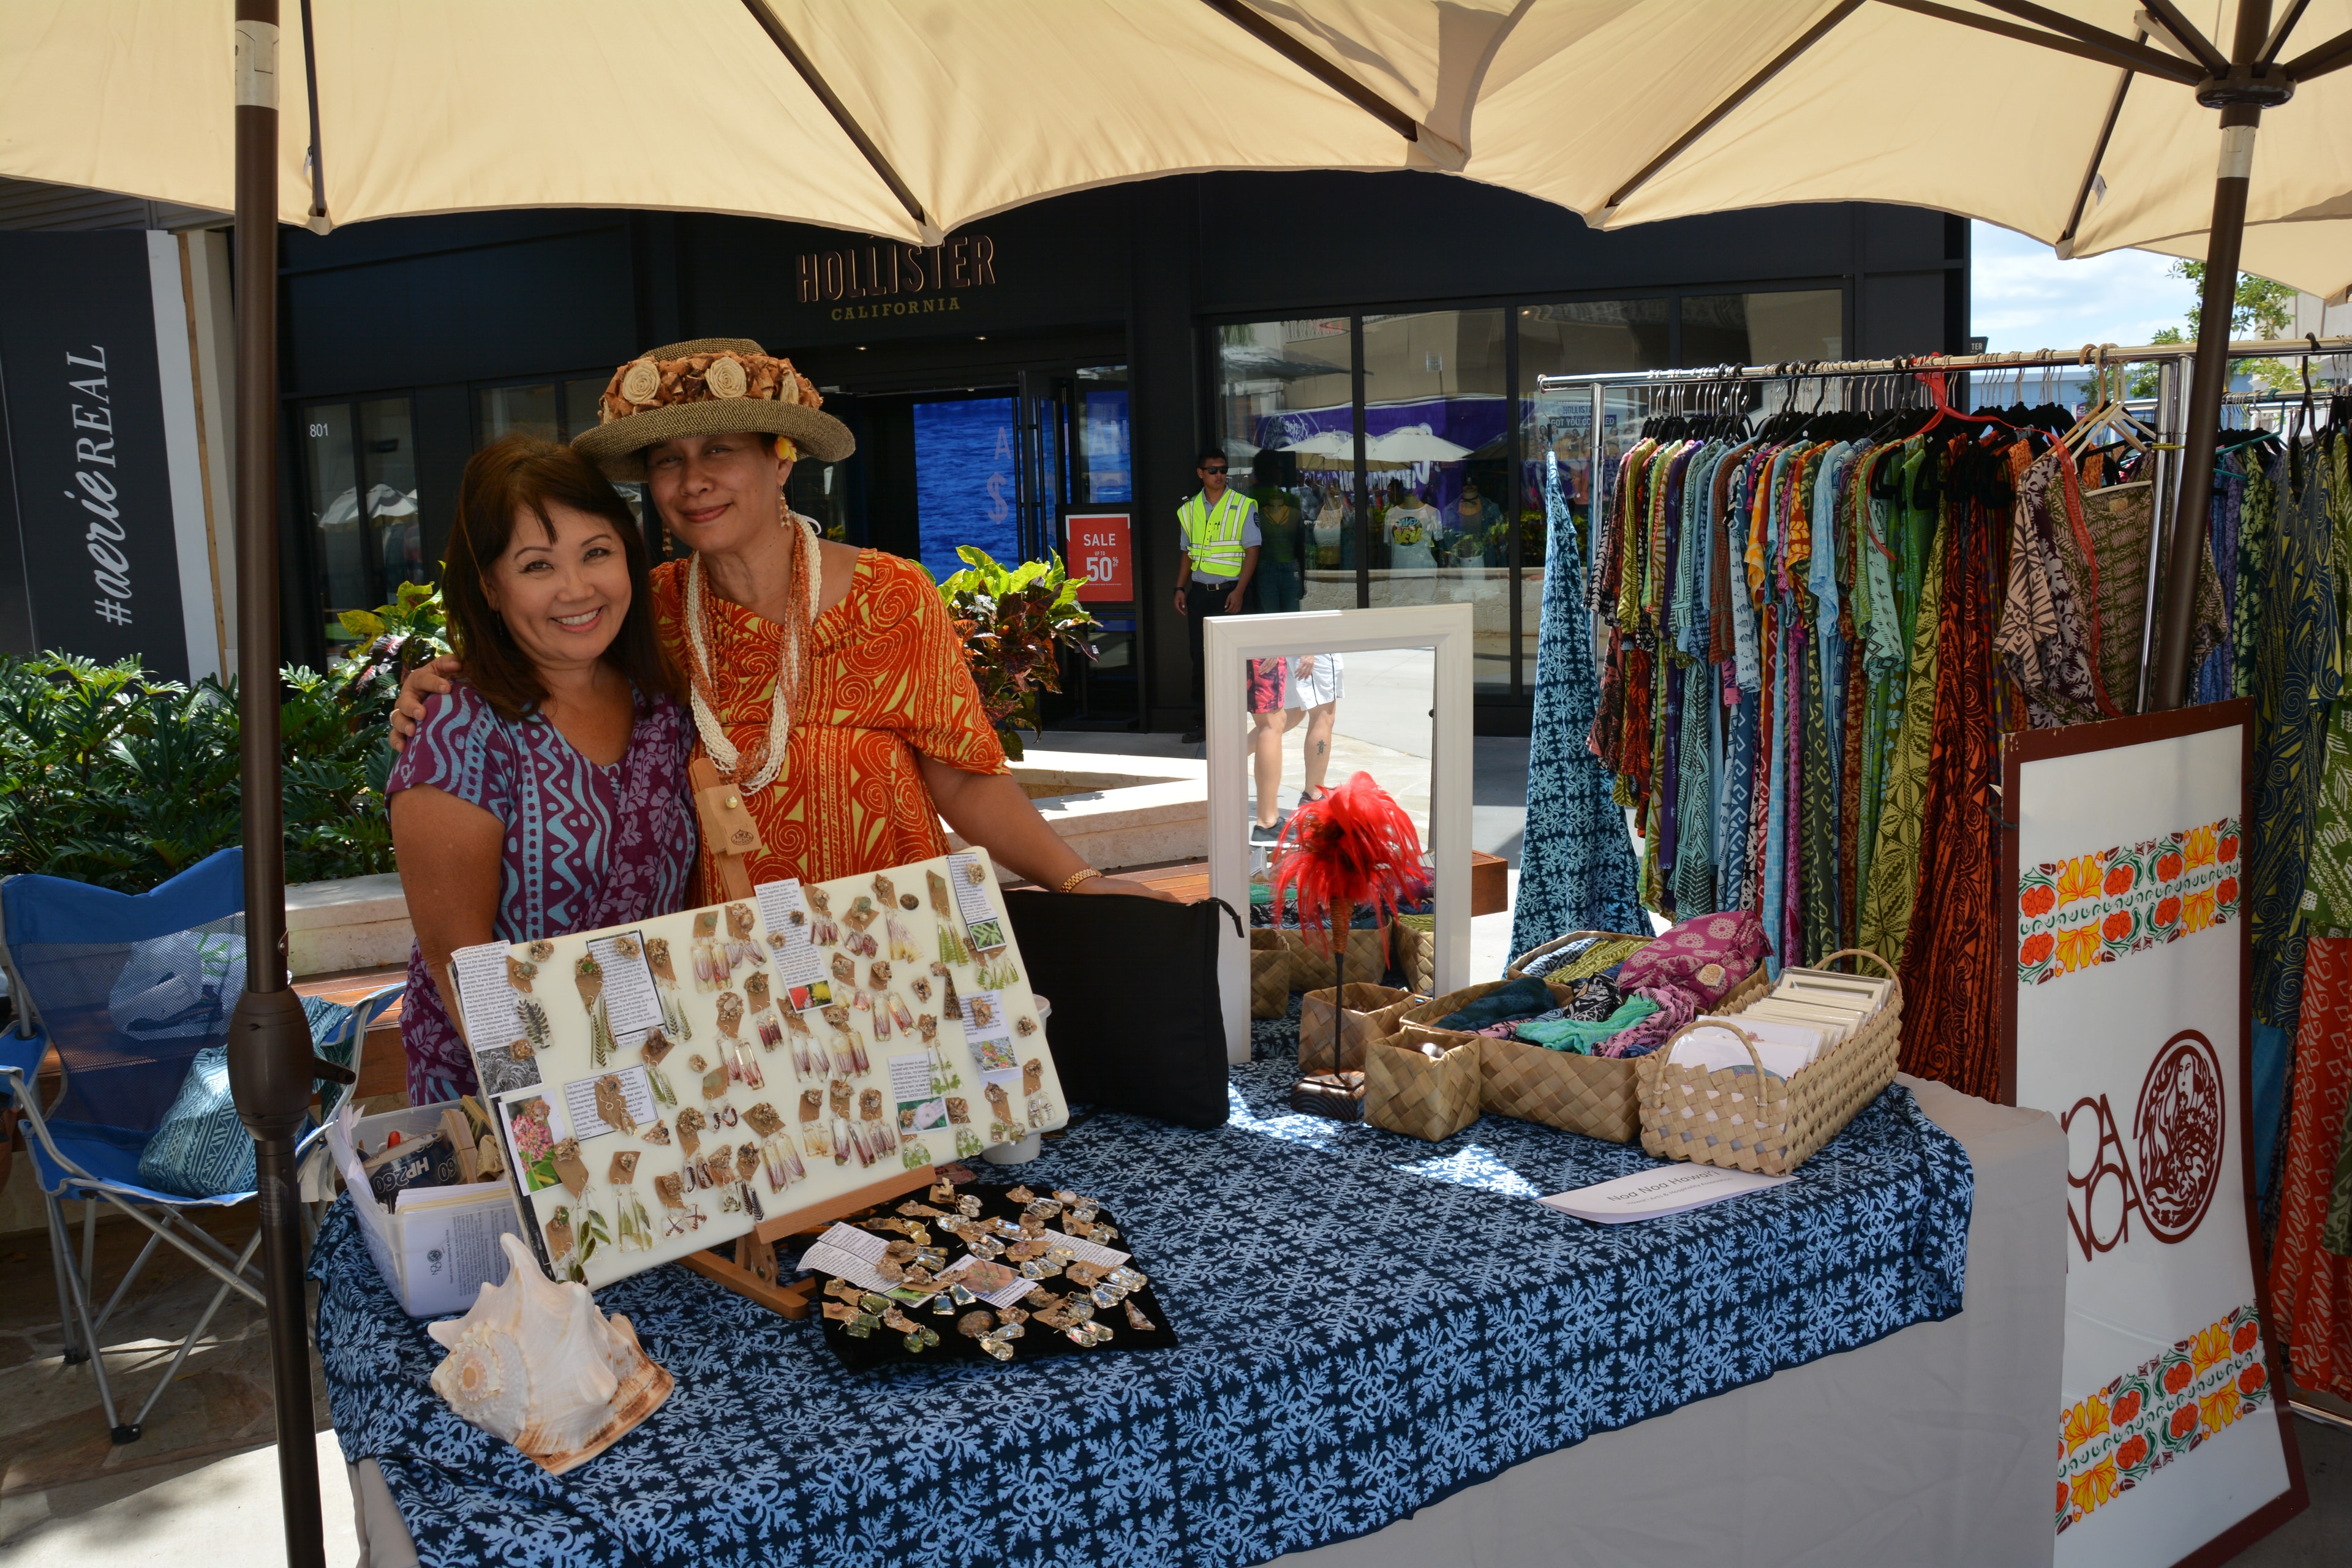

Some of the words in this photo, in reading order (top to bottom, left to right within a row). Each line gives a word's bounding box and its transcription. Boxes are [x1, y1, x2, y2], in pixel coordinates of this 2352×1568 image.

[795, 235, 995, 303] HOLLISTER
[831, 297, 960, 321] CALIFORNIA
[309, 423, 329, 437] 801
[1582, 417, 1615, 426] COED
[1083, 533, 1116, 546] SALE
[374, 1156, 429, 1194] HP260
[1607, 1191, 1638, 1202] Noa
[1638, 1182, 1669, 1194] Noa
